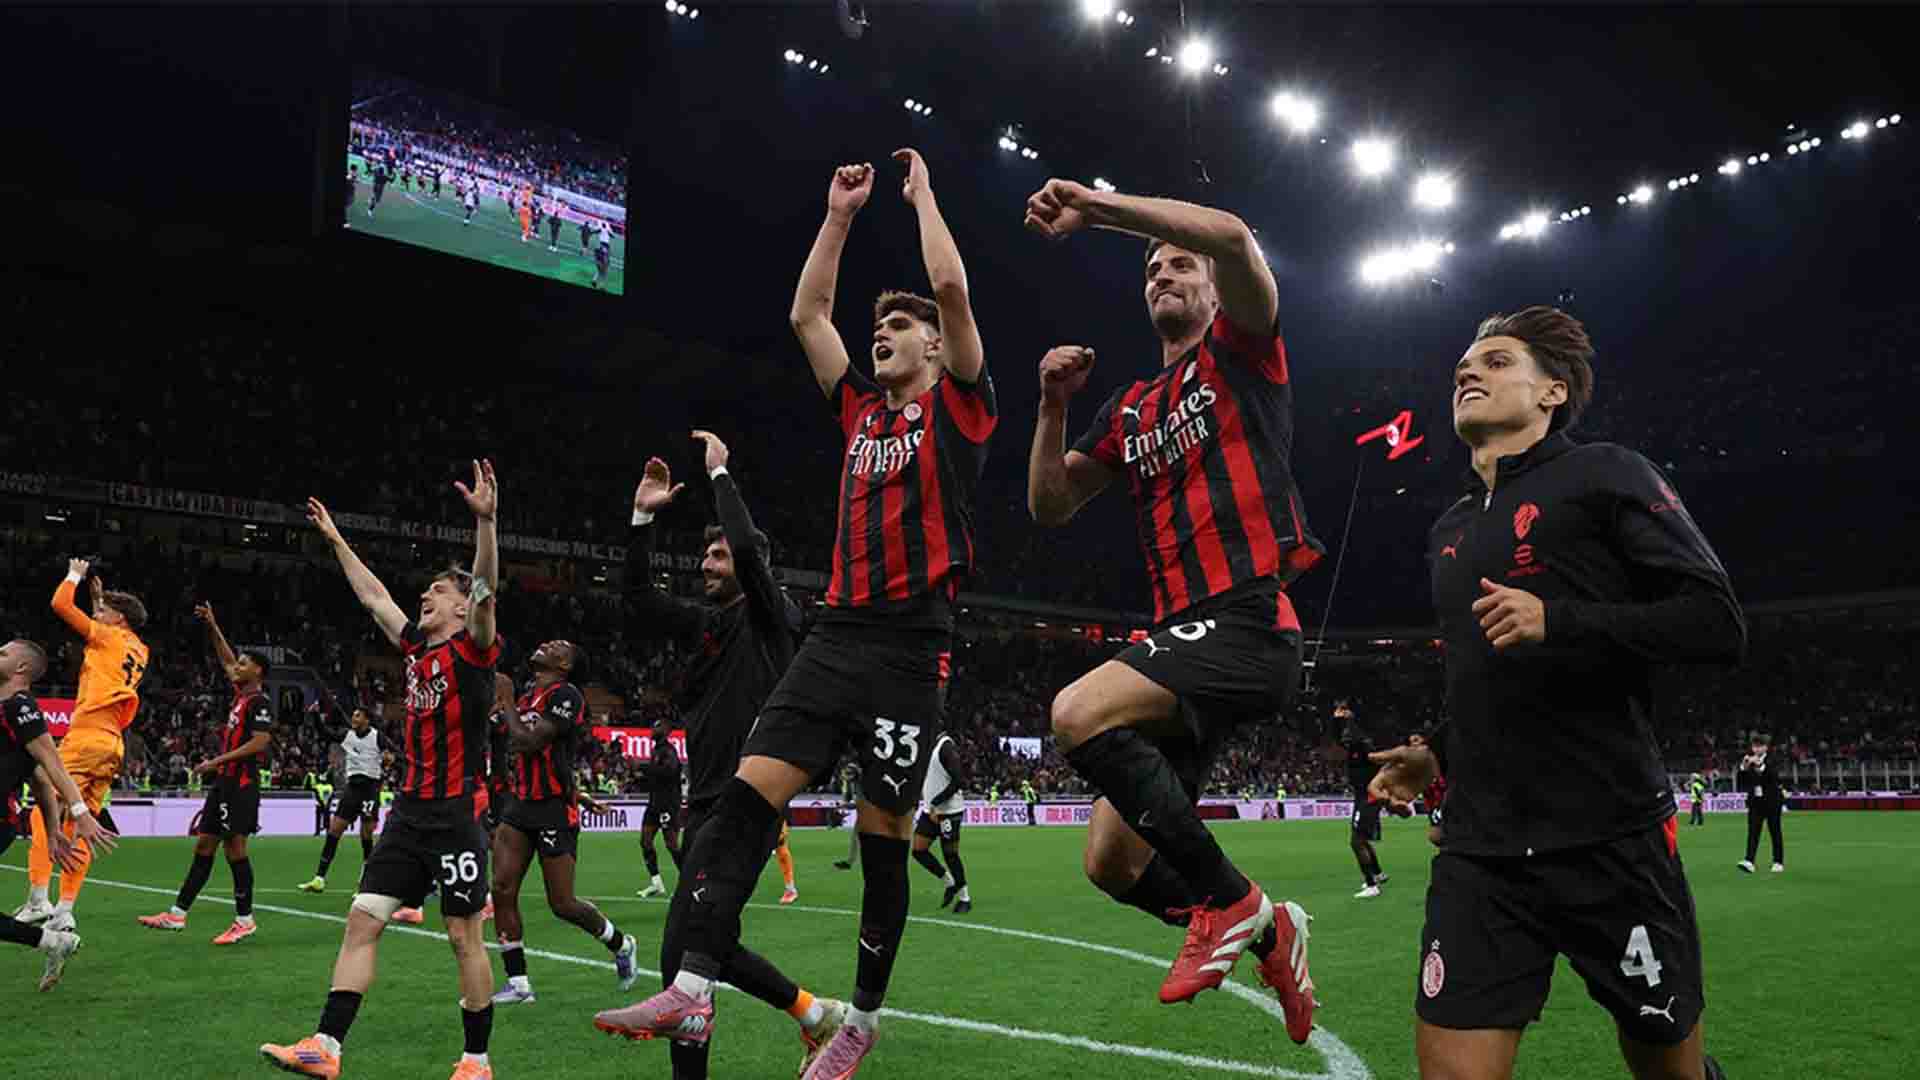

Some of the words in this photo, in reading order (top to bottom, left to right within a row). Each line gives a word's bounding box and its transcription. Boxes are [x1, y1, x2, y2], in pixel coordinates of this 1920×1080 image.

[1124, 384, 1217, 463] Emirates
[873, 718, 920, 768] 33
[219, 803, 229, 820] 5
[440, 852, 479, 886] 56
[1619, 924, 1663, 988] 4
